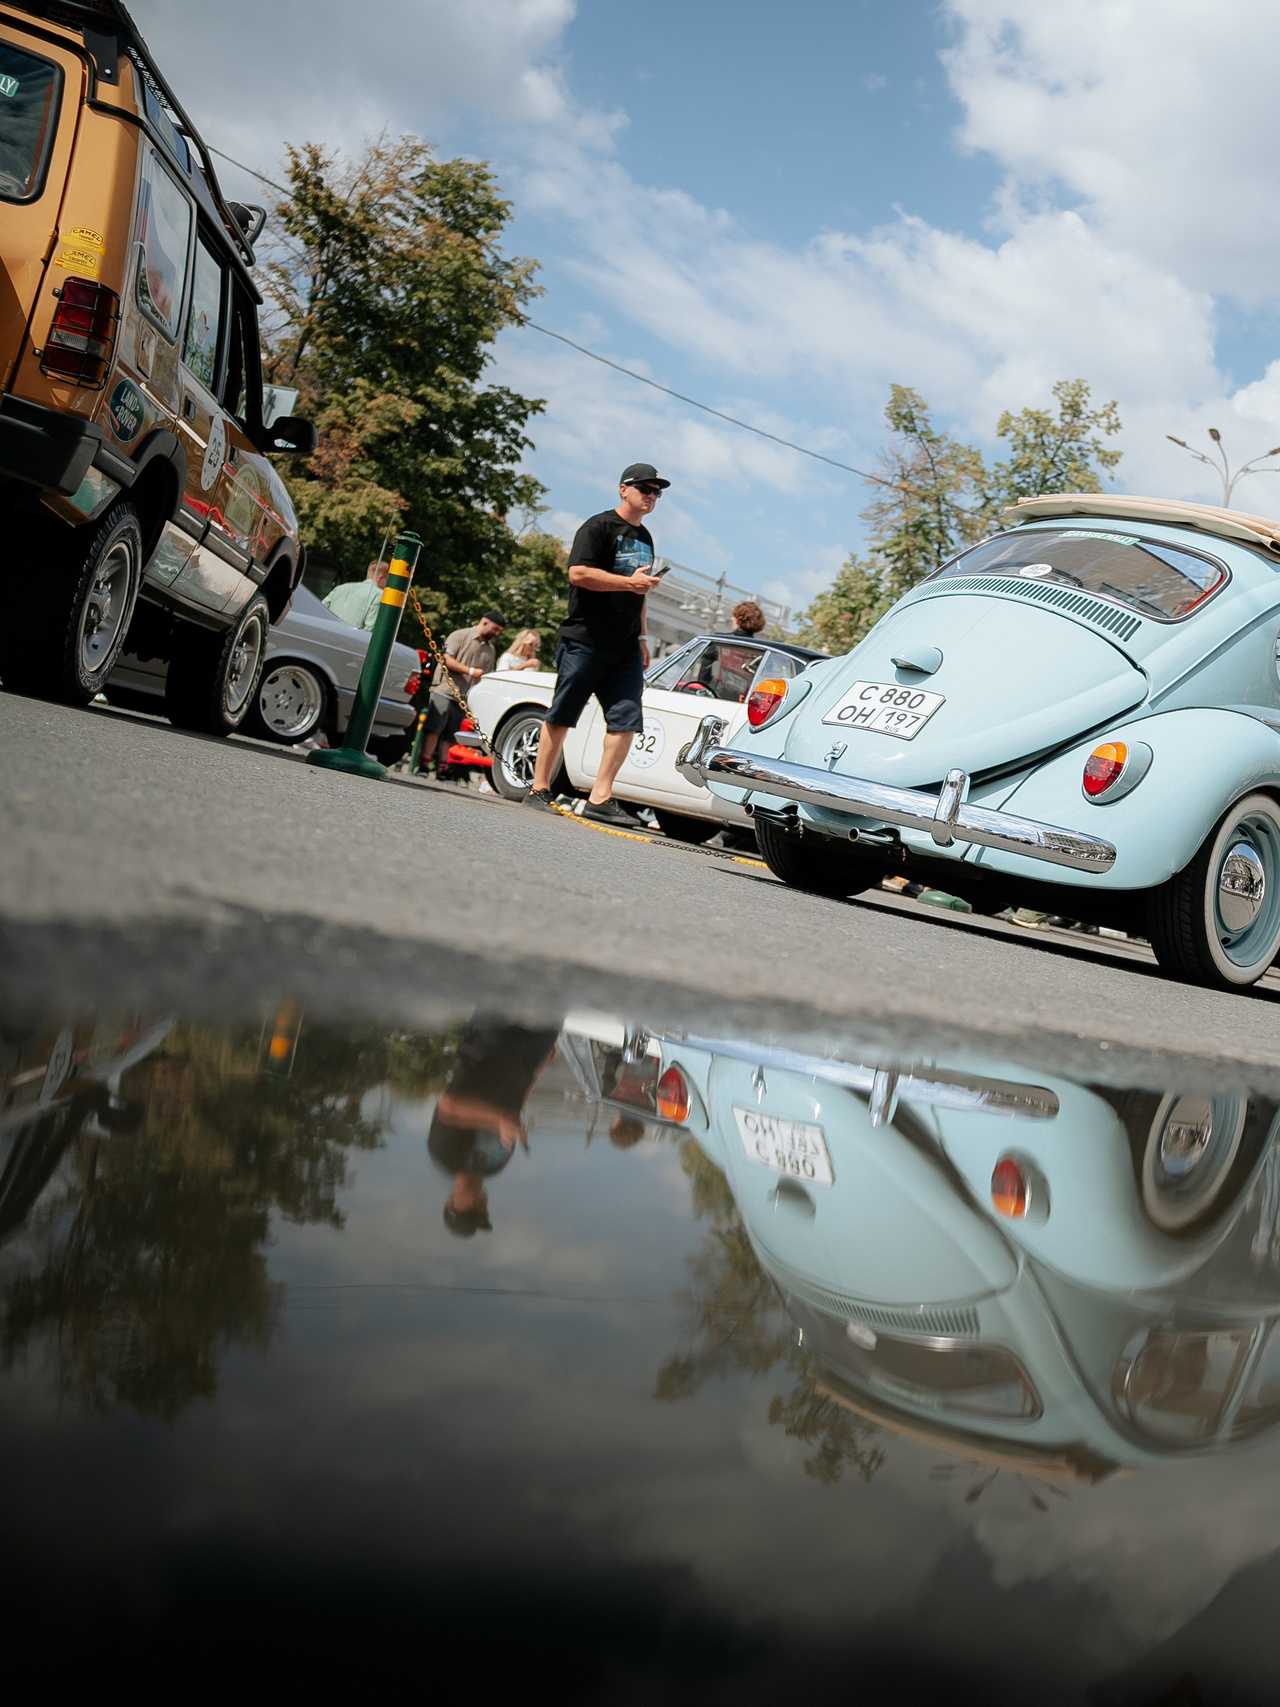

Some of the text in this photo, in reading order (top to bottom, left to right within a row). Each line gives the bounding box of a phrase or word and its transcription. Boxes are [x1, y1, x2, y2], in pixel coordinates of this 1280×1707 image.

[0, 76, 16, 93] LY
[72, 229, 101, 242] CAMEL
[63, 250, 94, 265] CAMEL
[120, 387, 139, 412] LAND
[116, 409, 138, 433] ROVER
[859, 685, 926, 709] C 880
[837, 705, 921, 729] OH 197
[884, 725, 900, 733] RUS
[635, 733, 656, 753] 32
